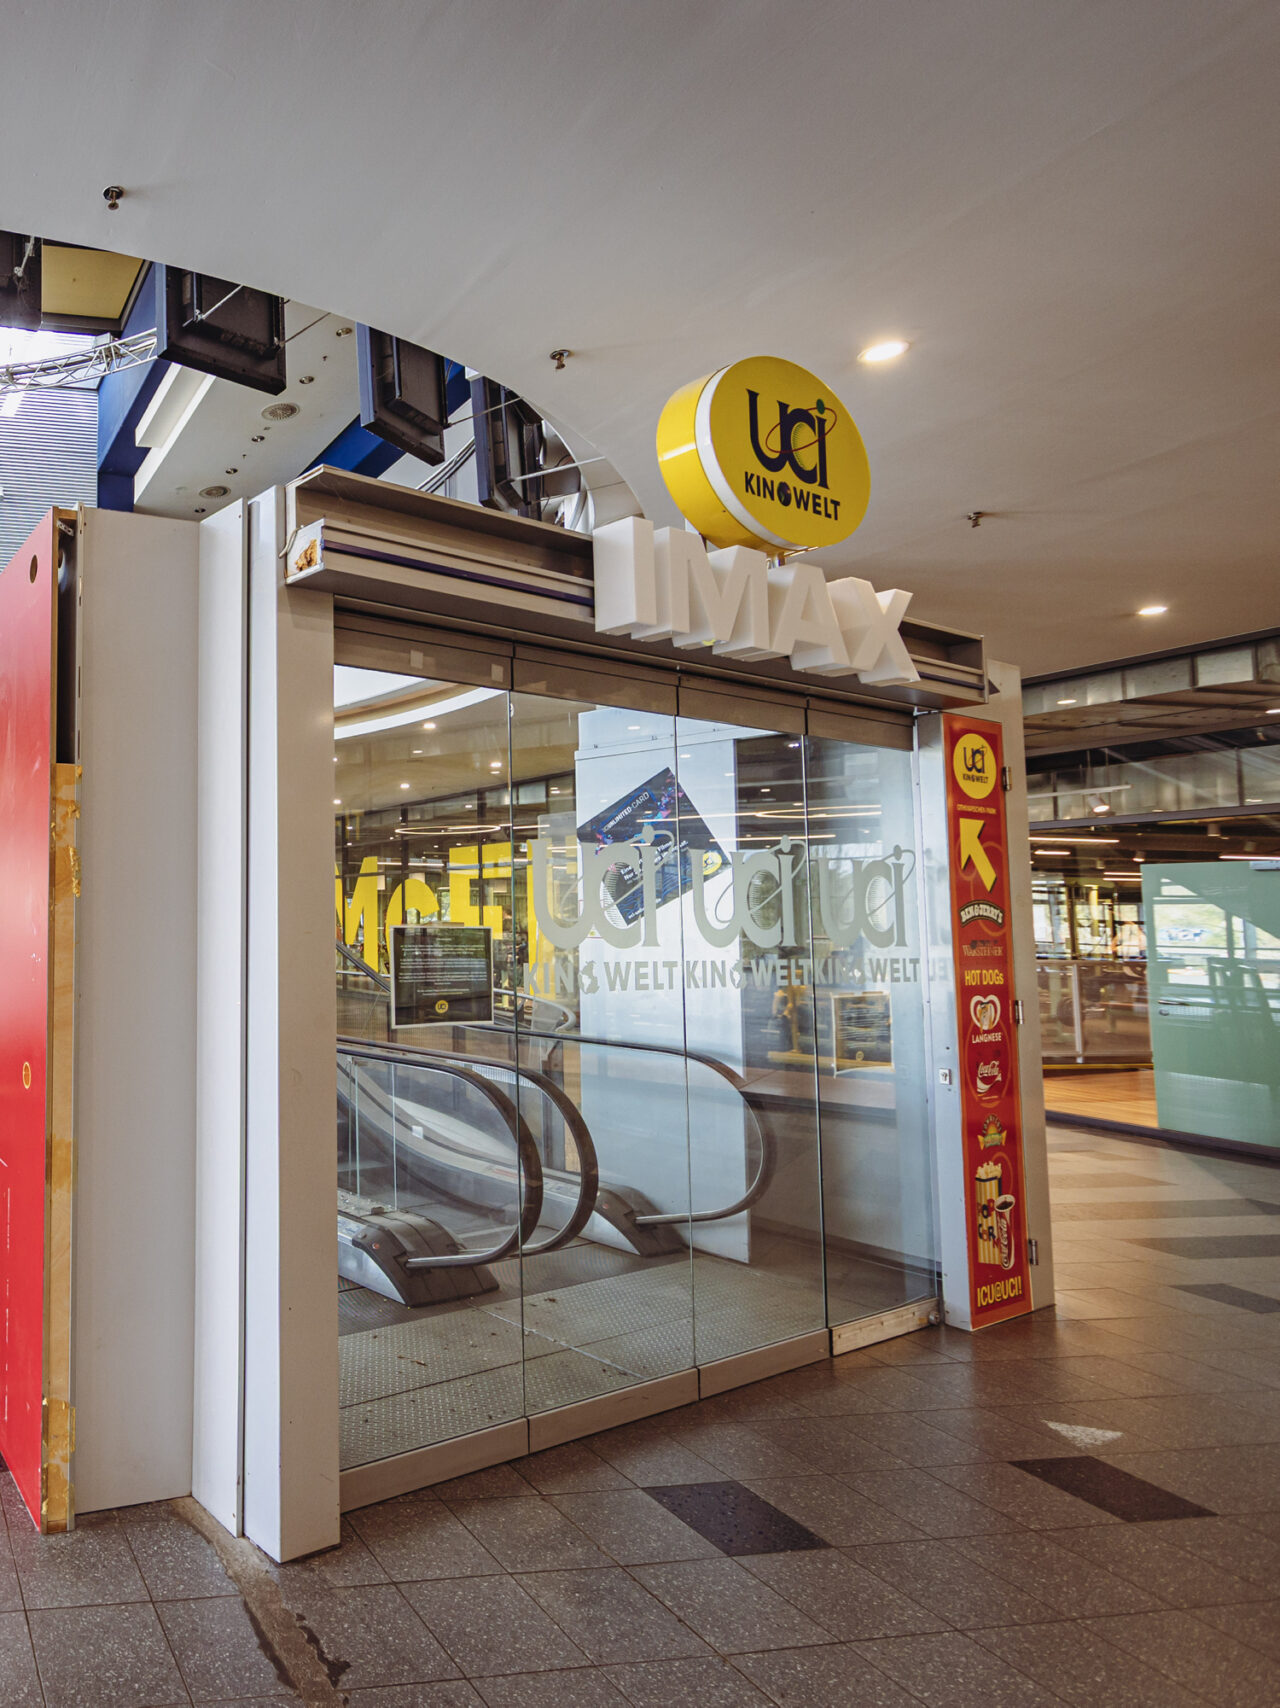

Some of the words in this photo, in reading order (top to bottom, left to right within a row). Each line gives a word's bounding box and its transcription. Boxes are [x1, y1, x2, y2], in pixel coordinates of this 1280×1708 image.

[594, 516, 921, 686] IMAX
[964, 969, 982, 986] HOT
[971, 1032, 1002, 1044] LANGNESE
